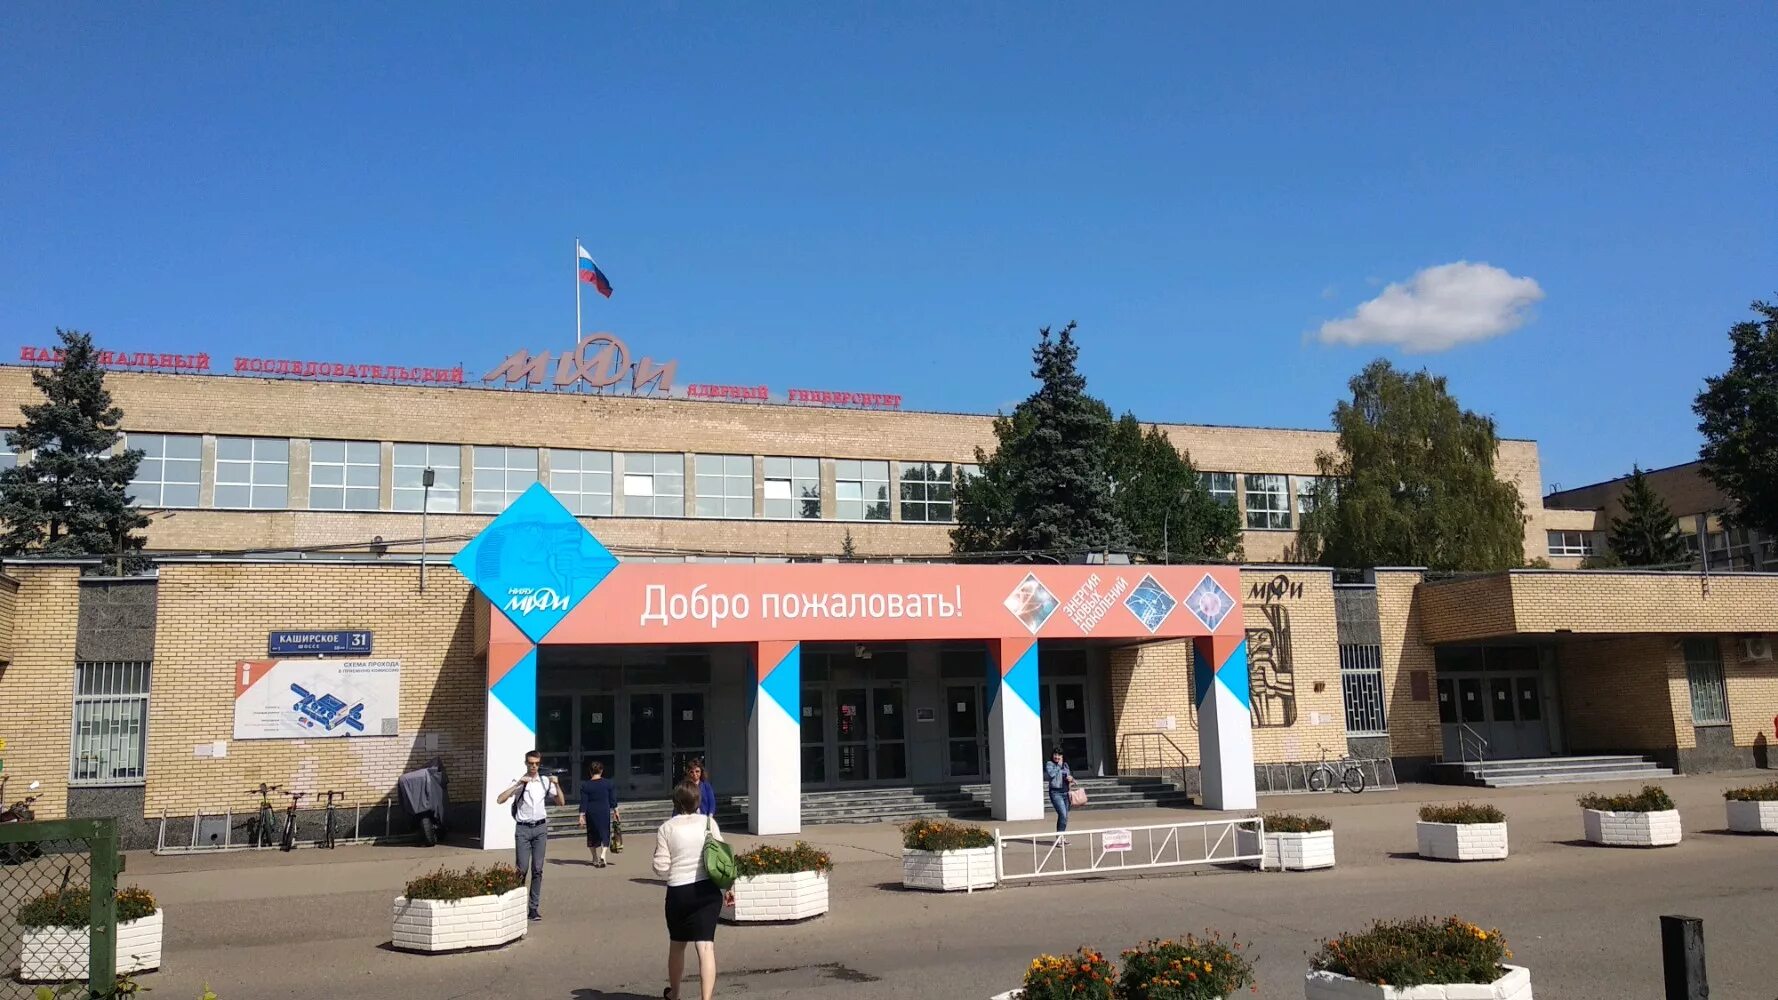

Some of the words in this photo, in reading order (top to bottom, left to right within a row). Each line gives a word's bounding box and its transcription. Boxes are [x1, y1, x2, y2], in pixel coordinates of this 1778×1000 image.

[234, 357, 464, 383] ИССЛЕДОВАТЕЛЬСКИЙ
[687, 383, 768, 400] ЯДЕРНЫЙ
[788, 388, 902, 406] УНИВЕРСИТЕТ
[508, 587, 535, 595] НИЯУ
[1062, 572, 1102, 617] ЭНЕРГИЯ
[640, 583, 750, 629] Добро
[761, 584, 963, 619] пожаловать!
[1071, 589, 1103, 626] НОВЫХ
[1079, 575, 1129, 635] ПОКОЛЕНИЙ
[279, 634, 339, 644] КАШИРСКОЕ
[351, 633, 366, 646] 31
